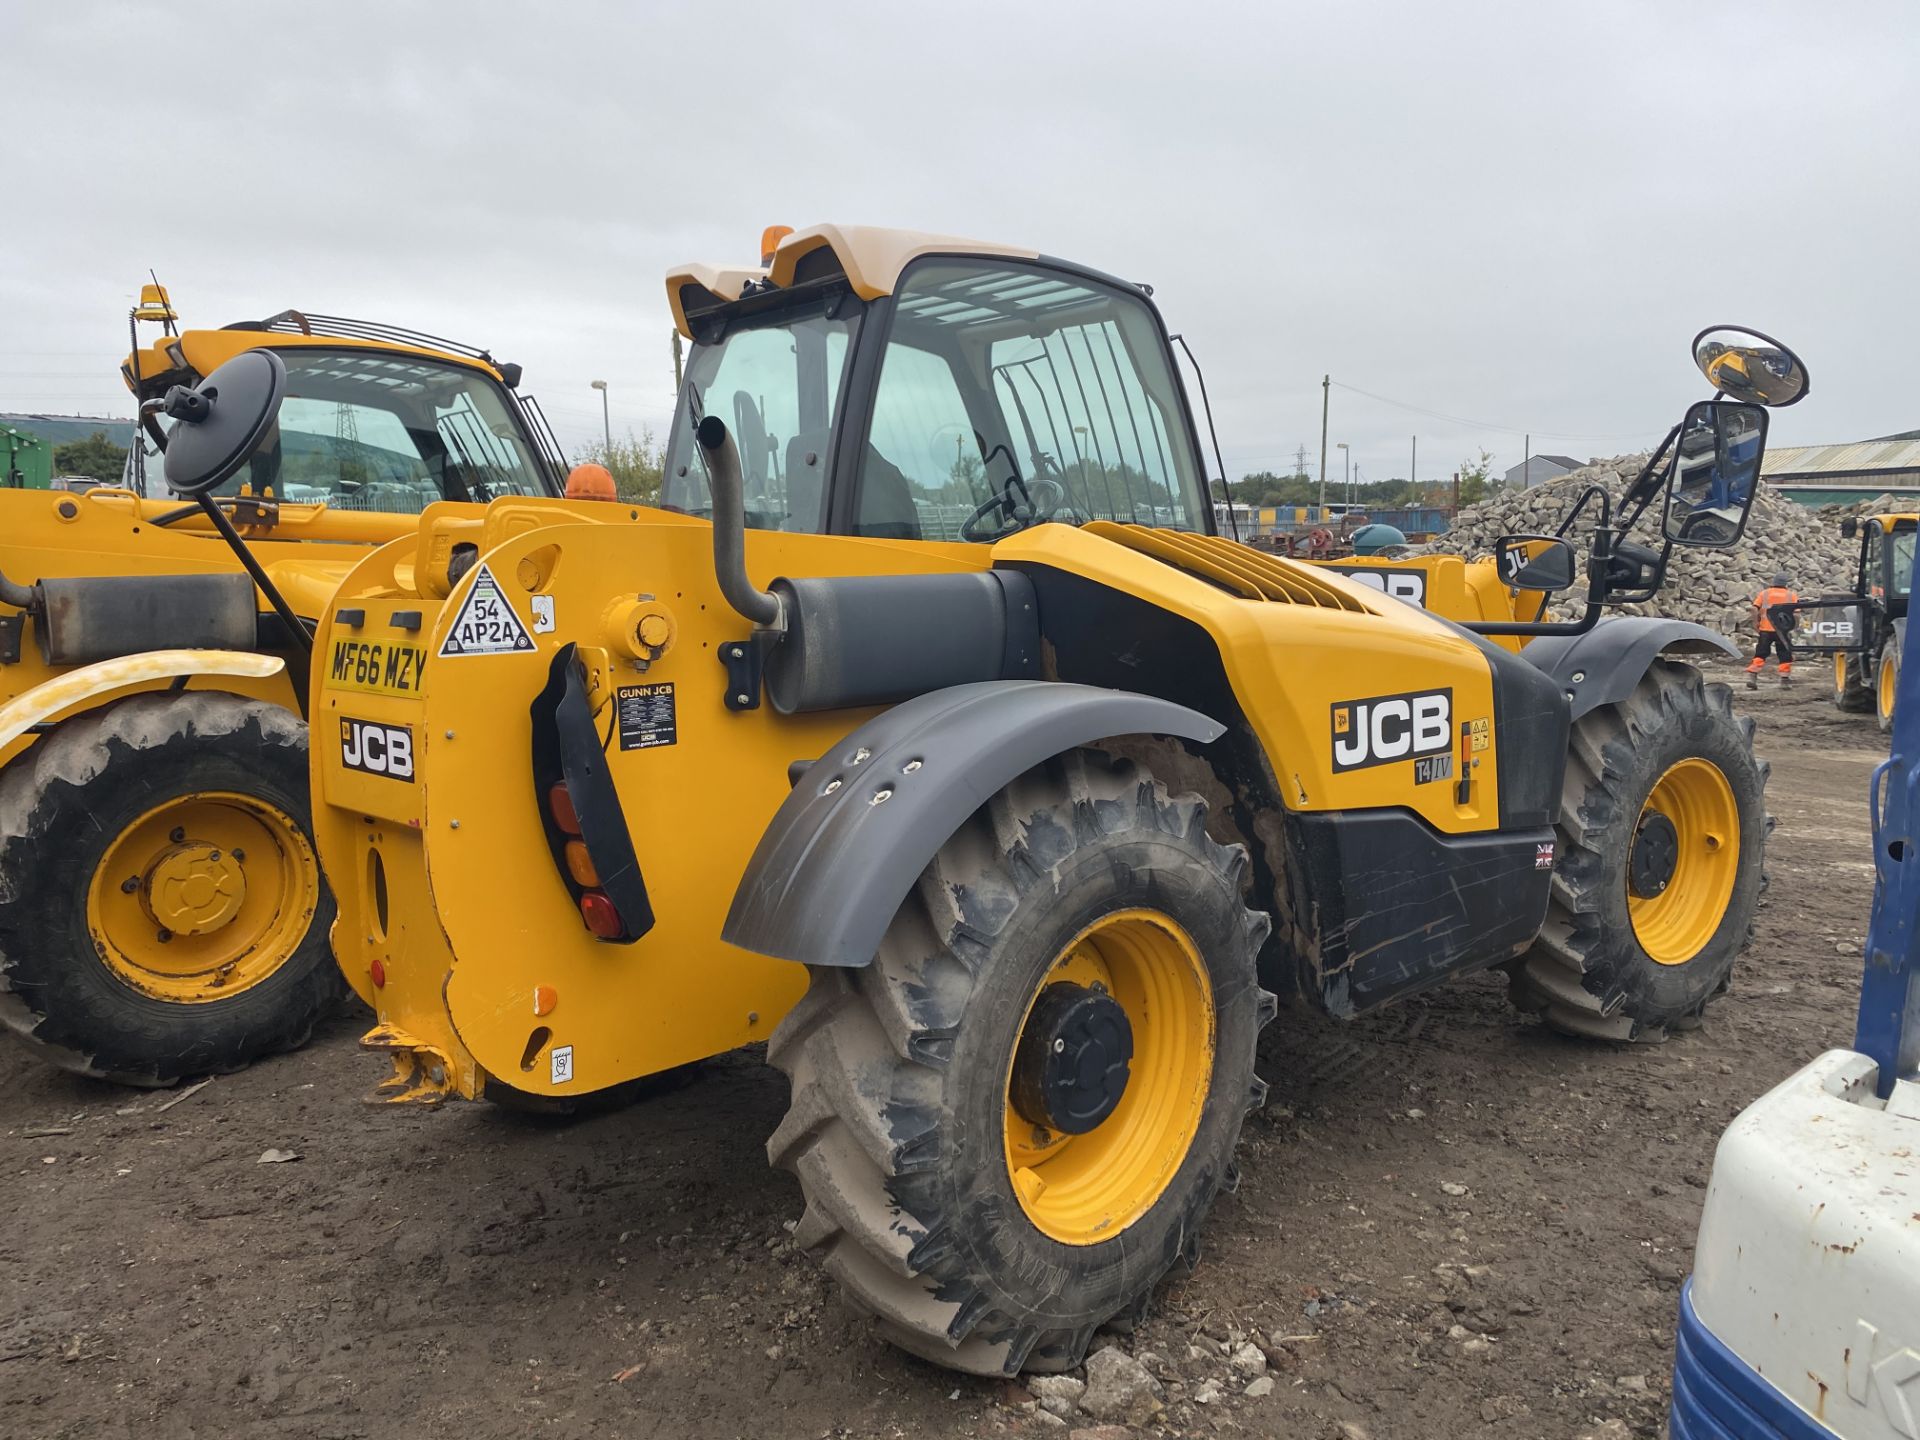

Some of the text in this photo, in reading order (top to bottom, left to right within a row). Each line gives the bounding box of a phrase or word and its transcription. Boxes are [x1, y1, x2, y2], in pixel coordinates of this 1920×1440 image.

[475, 599, 499, 620] 54
[462, 622, 514, 644] AP2A
[1803, 621, 1854, 634] JCB
[332, 641, 427, 691] MF66 MZY
[620, 685, 673, 698] GUNN JCB
[1335, 694, 1450, 766] JCB
[343, 723, 413, 777] JCB
[1416, 761, 1431, 783] T4
